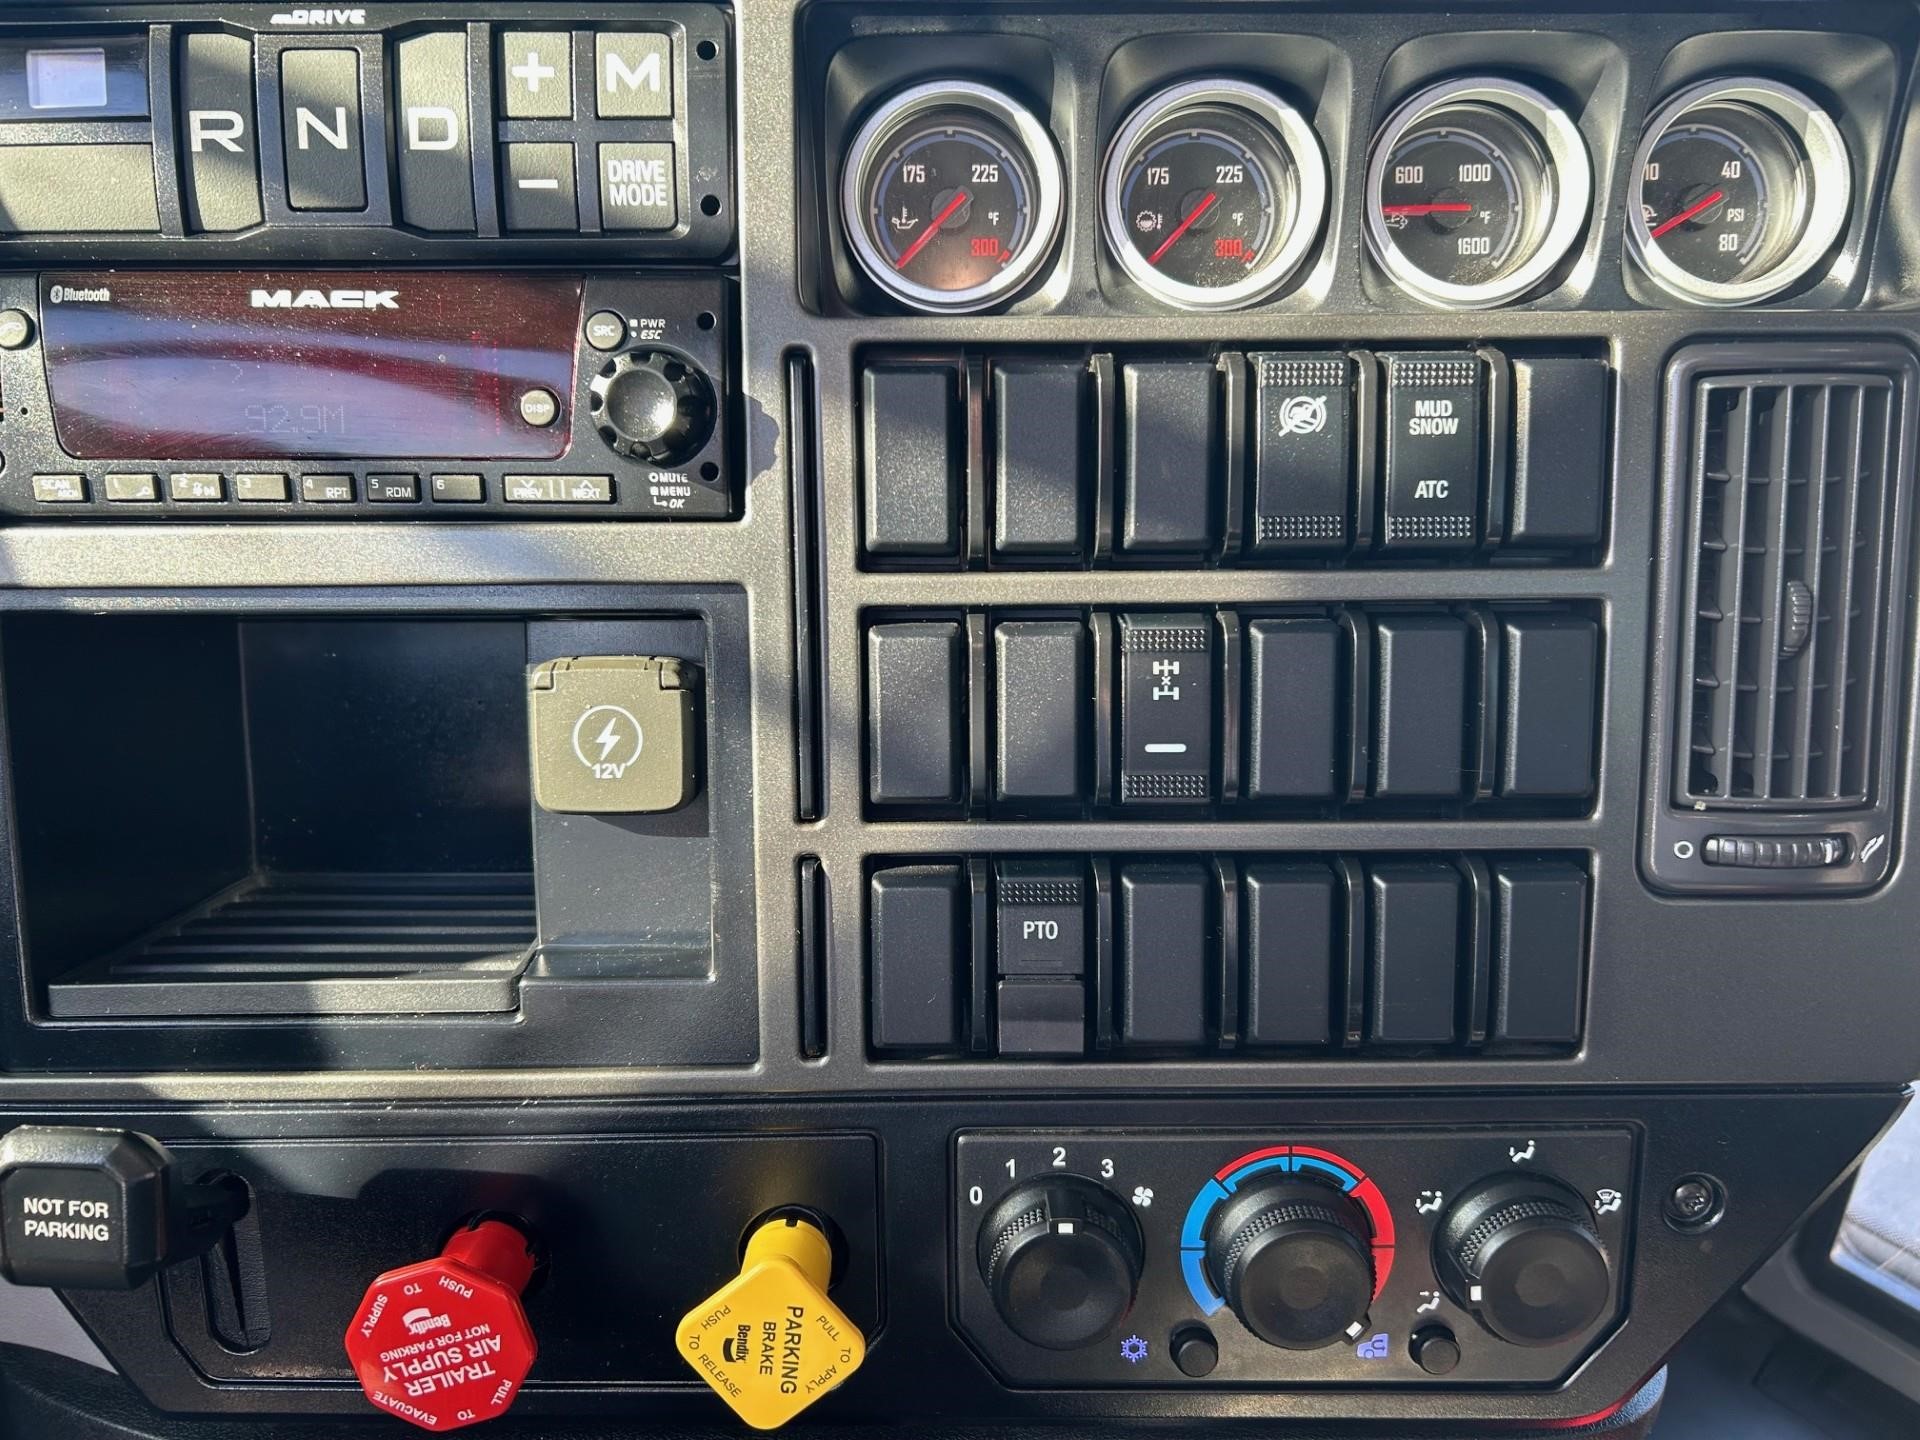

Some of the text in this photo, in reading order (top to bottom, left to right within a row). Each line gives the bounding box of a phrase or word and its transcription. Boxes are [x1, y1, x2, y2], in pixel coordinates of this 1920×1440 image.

[605, 53, 660, 93] M
[189, 110, 245, 153] R
[296, 106, 348, 150] N
[407, 106, 459, 151] D
[607, 160, 667, 183] DRIVE
[903, 165, 925, 183] 175
[971, 165, 999, 183] 225
[1147, 167, 1170, 185] 175
[1216, 165, 1243, 184] 225
[1395, 166, 1423, 184] 600
[1459, 164, 1491, 182] 1000
[1721, 161, 1741, 179] 40
[609, 183, 668, 207] MODE
[1727, 208, 1745, 222] PSI
[971, 238, 999, 257] 300
[1215, 239, 1243, 257] 300
[1458, 237, 1490, 255] 1600
[1719, 234, 1738, 251] 80
[63, 287, 111, 302] Bluetooth
[250, 289, 400, 309] MACK
[593, 325, 615, 337] SRC
[640, 318, 666, 329] PWR
[640, 329, 663, 340] ESC
[525, 403, 551, 413] DISP
[1415, 400, 1453, 417] MUD
[1409, 418, 1459, 435] SNOW
[240, 479, 251, 489] 3
[304, 479, 314, 489] 4
[371, 479, 379, 489] 5
[436, 480, 445, 490] 6
[660, 473, 688, 483] MUTE
[325, 488, 348, 499] RPT
[385, 487, 412, 498] RDM
[513, 487, 544, 499] PREV
[572, 488, 601, 499] NEXT
[660, 486, 691, 497] MENU
[1414, 480, 1449, 499] ATC
[668, 499, 685, 509] OK
[591, 763, 626, 779] 12V
[1023, 921, 1059, 940] PTO
[1052, 1147, 1067, 1168] 2
[1005, 1159, 1017, 1178] 1
[1101, 1159, 1115, 1178] 3
[969, 1187, 983, 1205] 0
[23, 1197, 109, 1219] NOT FOR
[24, 1220, 110, 1242] PARKING
[361, 1276, 474, 1338] PUSH TO SUPPLY
[409, 1313, 451, 1335] Bendix
[380, 1323, 491, 1362] NOT FOR PARKING
[688, 1305, 742, 1398] PUSH TO RELEASE
[735, 1324, 751, 1362] Bendix
[759, 1321, 777, 1375] BRAKE
[780, 1305, 804, 1394] PARKING
[383, 1335, 501, 1383] AIR SUPPLY
[805, 1315, 851, 1394] PULL TO APPLY
[404, 1360, 496, 1397] TRAILER
[372, 1379, 513, 1426] PULL TO EVACUATE
